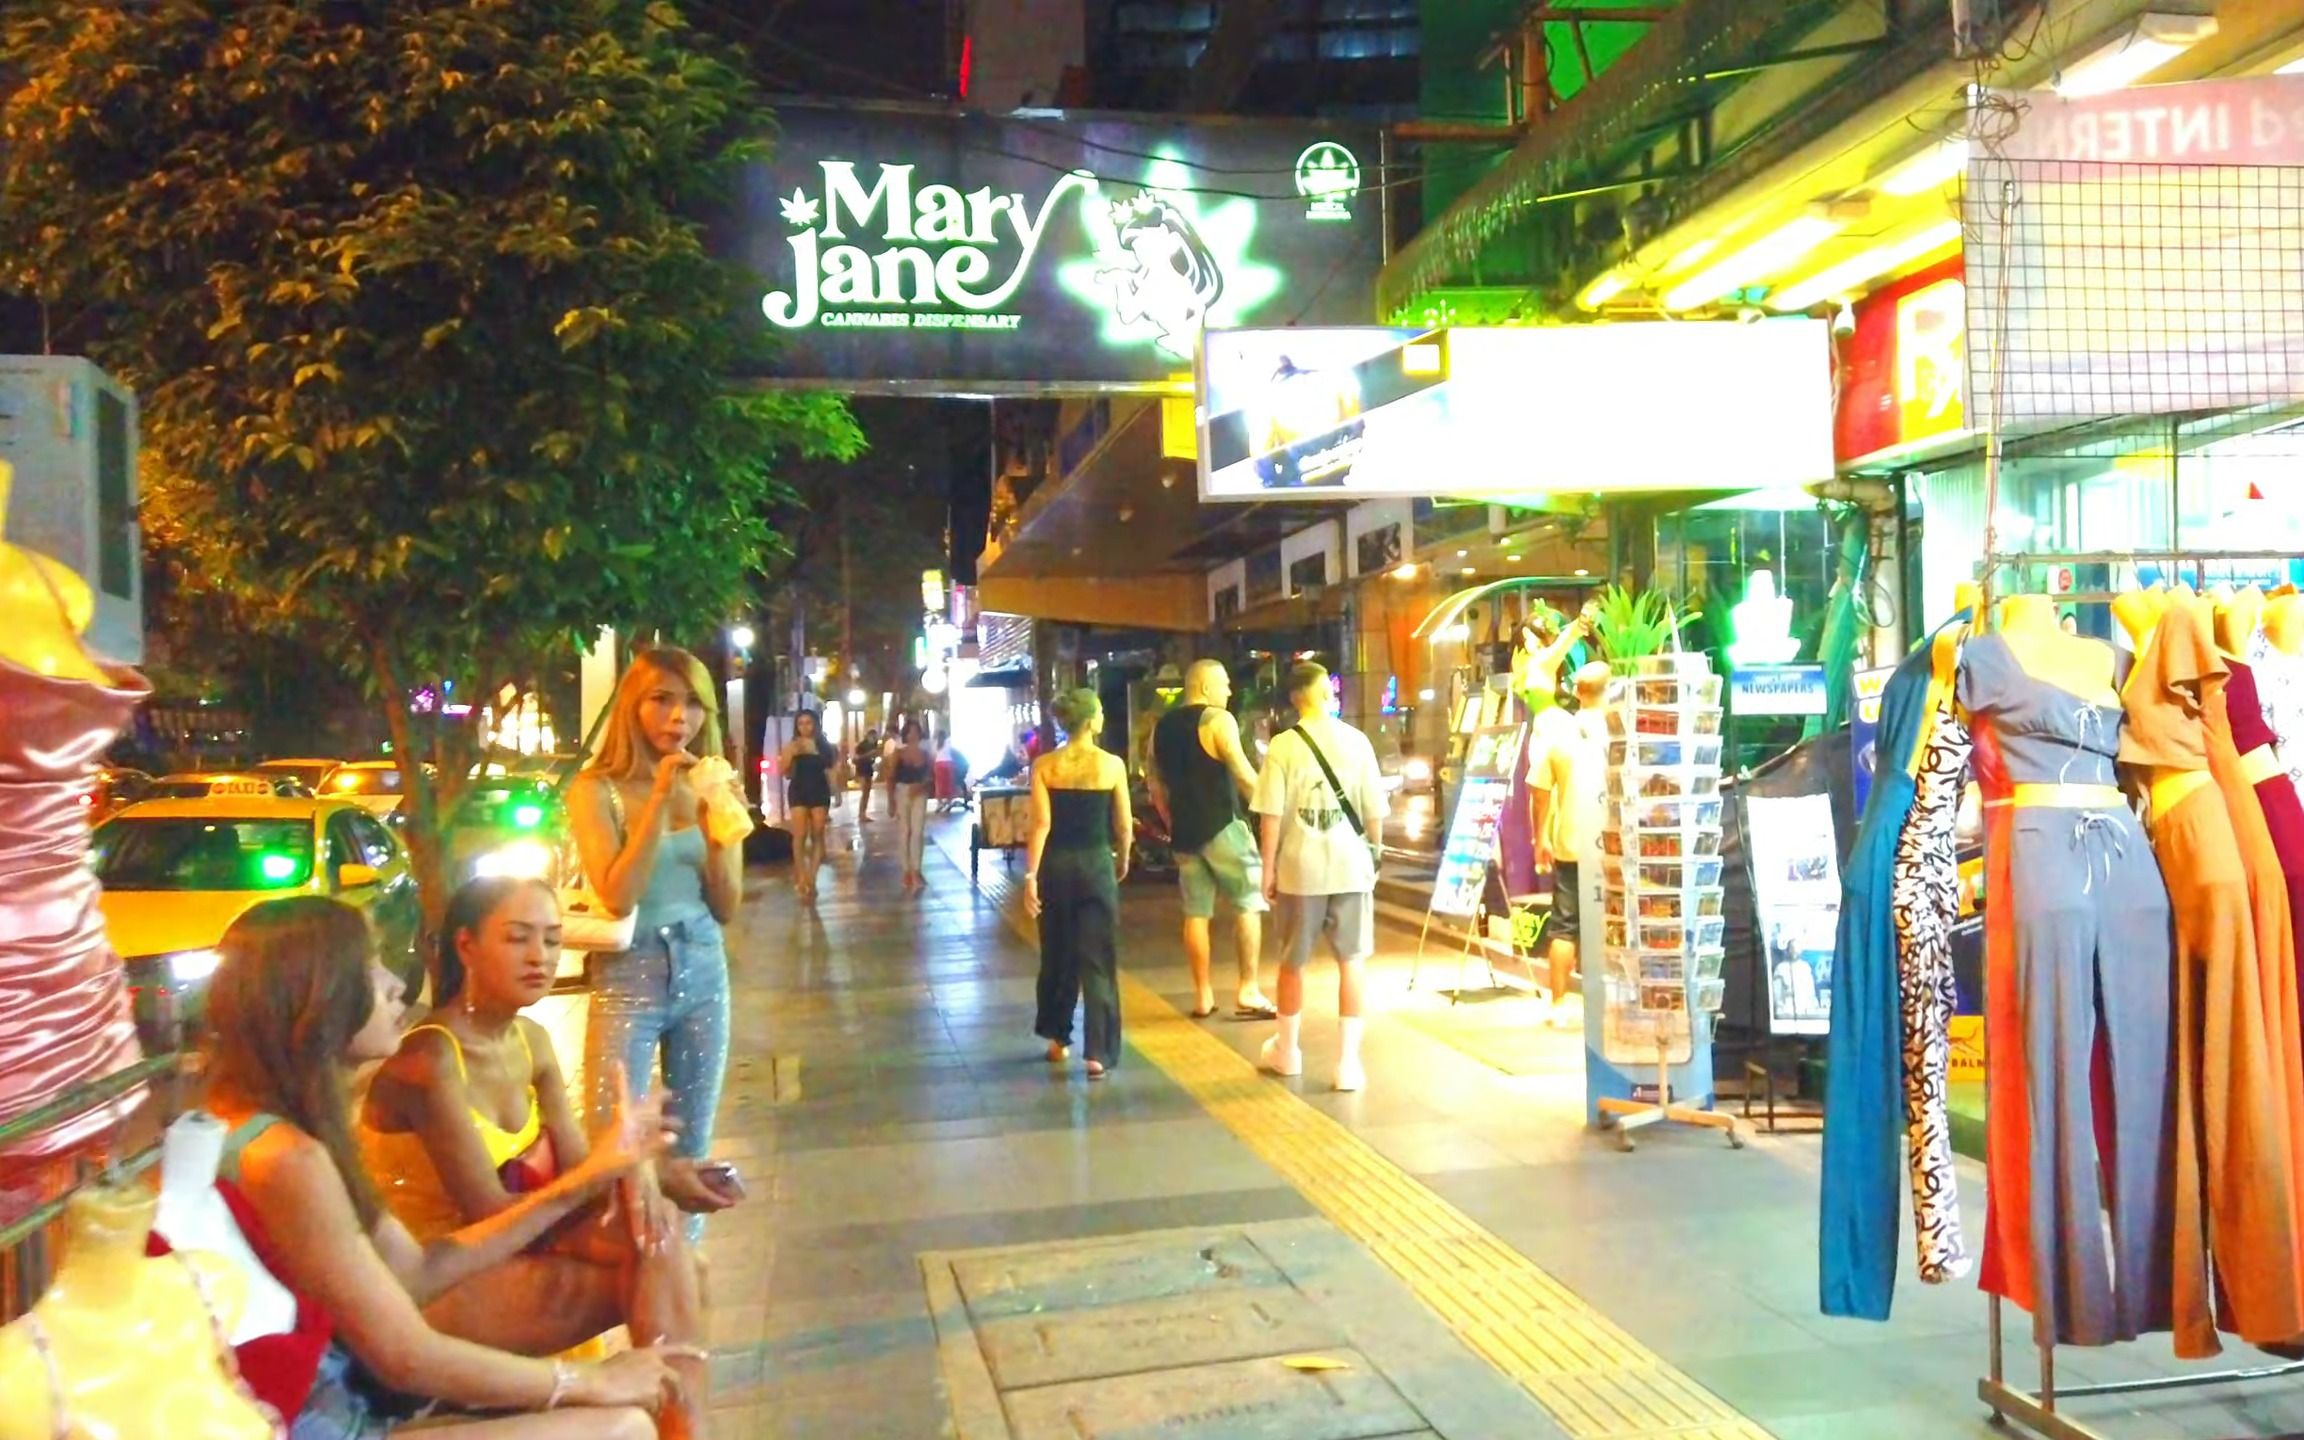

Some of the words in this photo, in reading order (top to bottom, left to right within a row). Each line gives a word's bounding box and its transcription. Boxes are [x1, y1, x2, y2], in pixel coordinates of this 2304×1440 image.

[818, 159, 1099, 252] Mary
[820, 311, 911, 328] CANNABIS
[912, 312, 1022, 330] DISPENSARY
[1741, 682, 1814, 695] NEWSPAPERS
